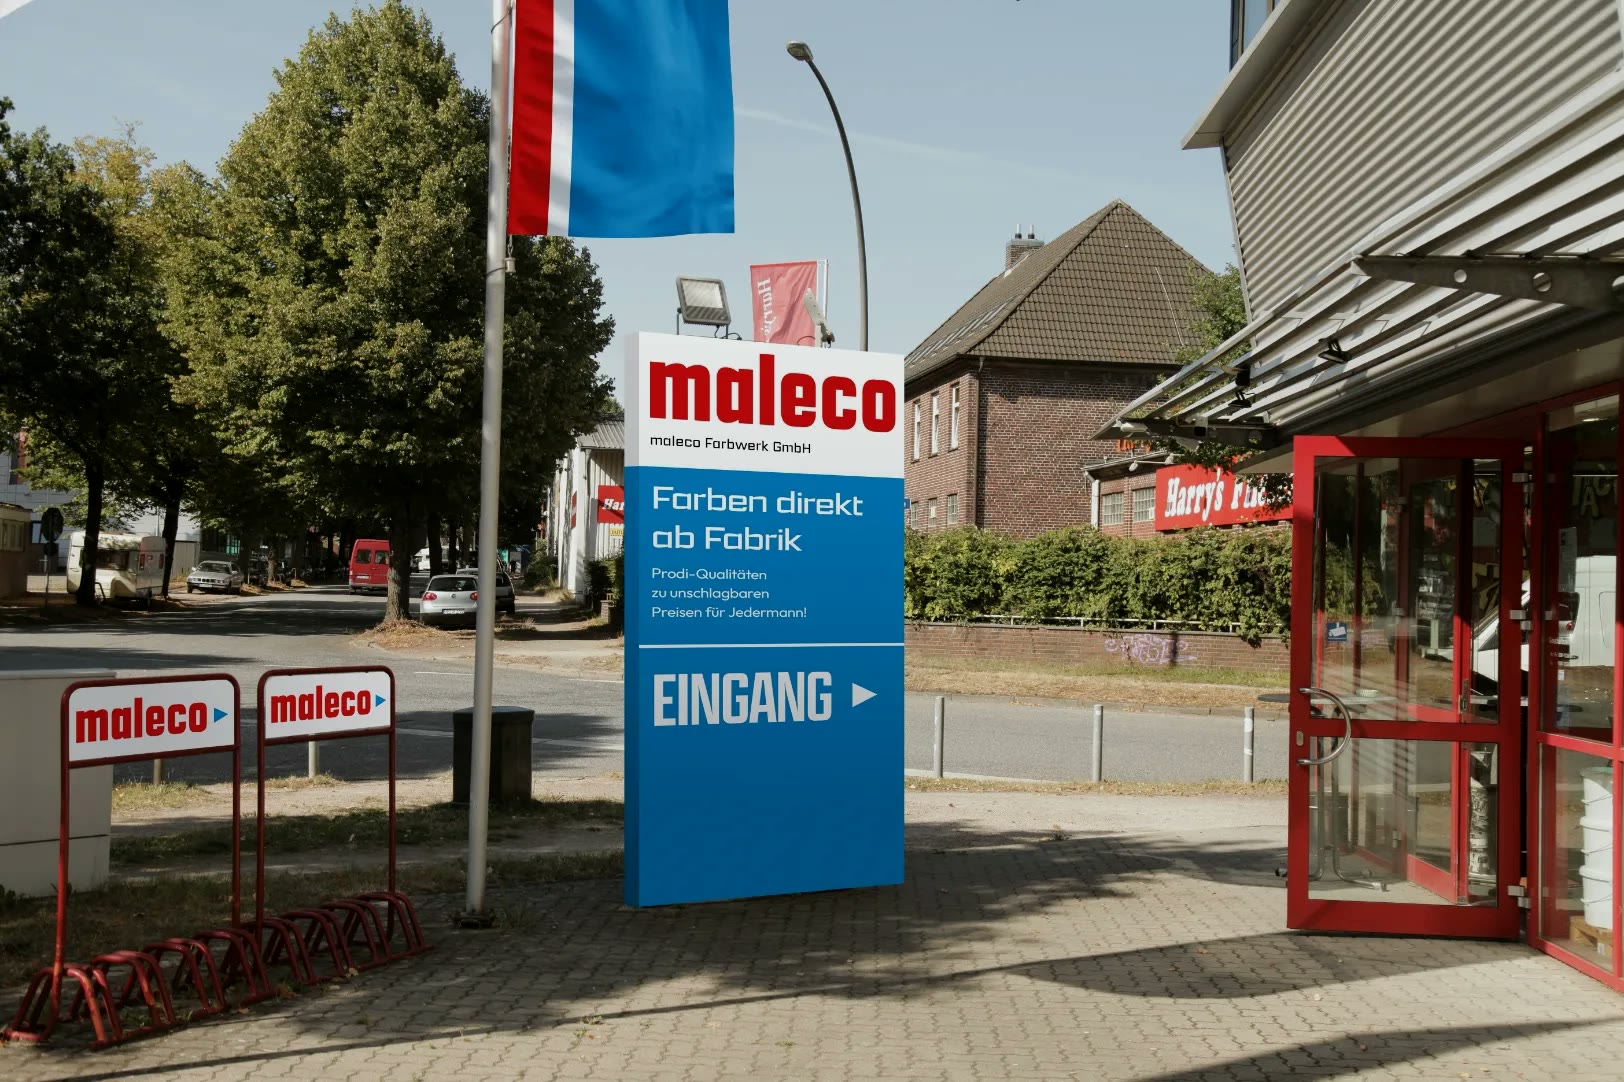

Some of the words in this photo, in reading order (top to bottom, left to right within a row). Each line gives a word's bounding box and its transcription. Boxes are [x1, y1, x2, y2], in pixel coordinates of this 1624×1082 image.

[649, 354, 896, 433] maleco
[650, 436, 701, 448] maleco
[705, 438, 769, 452] Farbwerk
[773, 441, 811, 454] GmbH
[652, 485, 767, 513] Farben
[776, 490, 864, 516] direkt
[1165, 468, 1225, 521] Harry's
[652, 524, 695, 549] ab
[705, 526, 802, 552] Fabrik
[651, 567, 767, 580] Prodi-Qualitäten
[651, 589, 667, 599] zu
[670, 587, 770, 601] unschlagbaren
[651, 606, 702, 618] Preisen
[705, 606, 726, 618] für
[728, 607, 808, 619] Jedermann!
[271, 685, 371, 724] maleco
[653, 671, 832, 727] EINGANG
[75, 697, 208, 744] maleco
